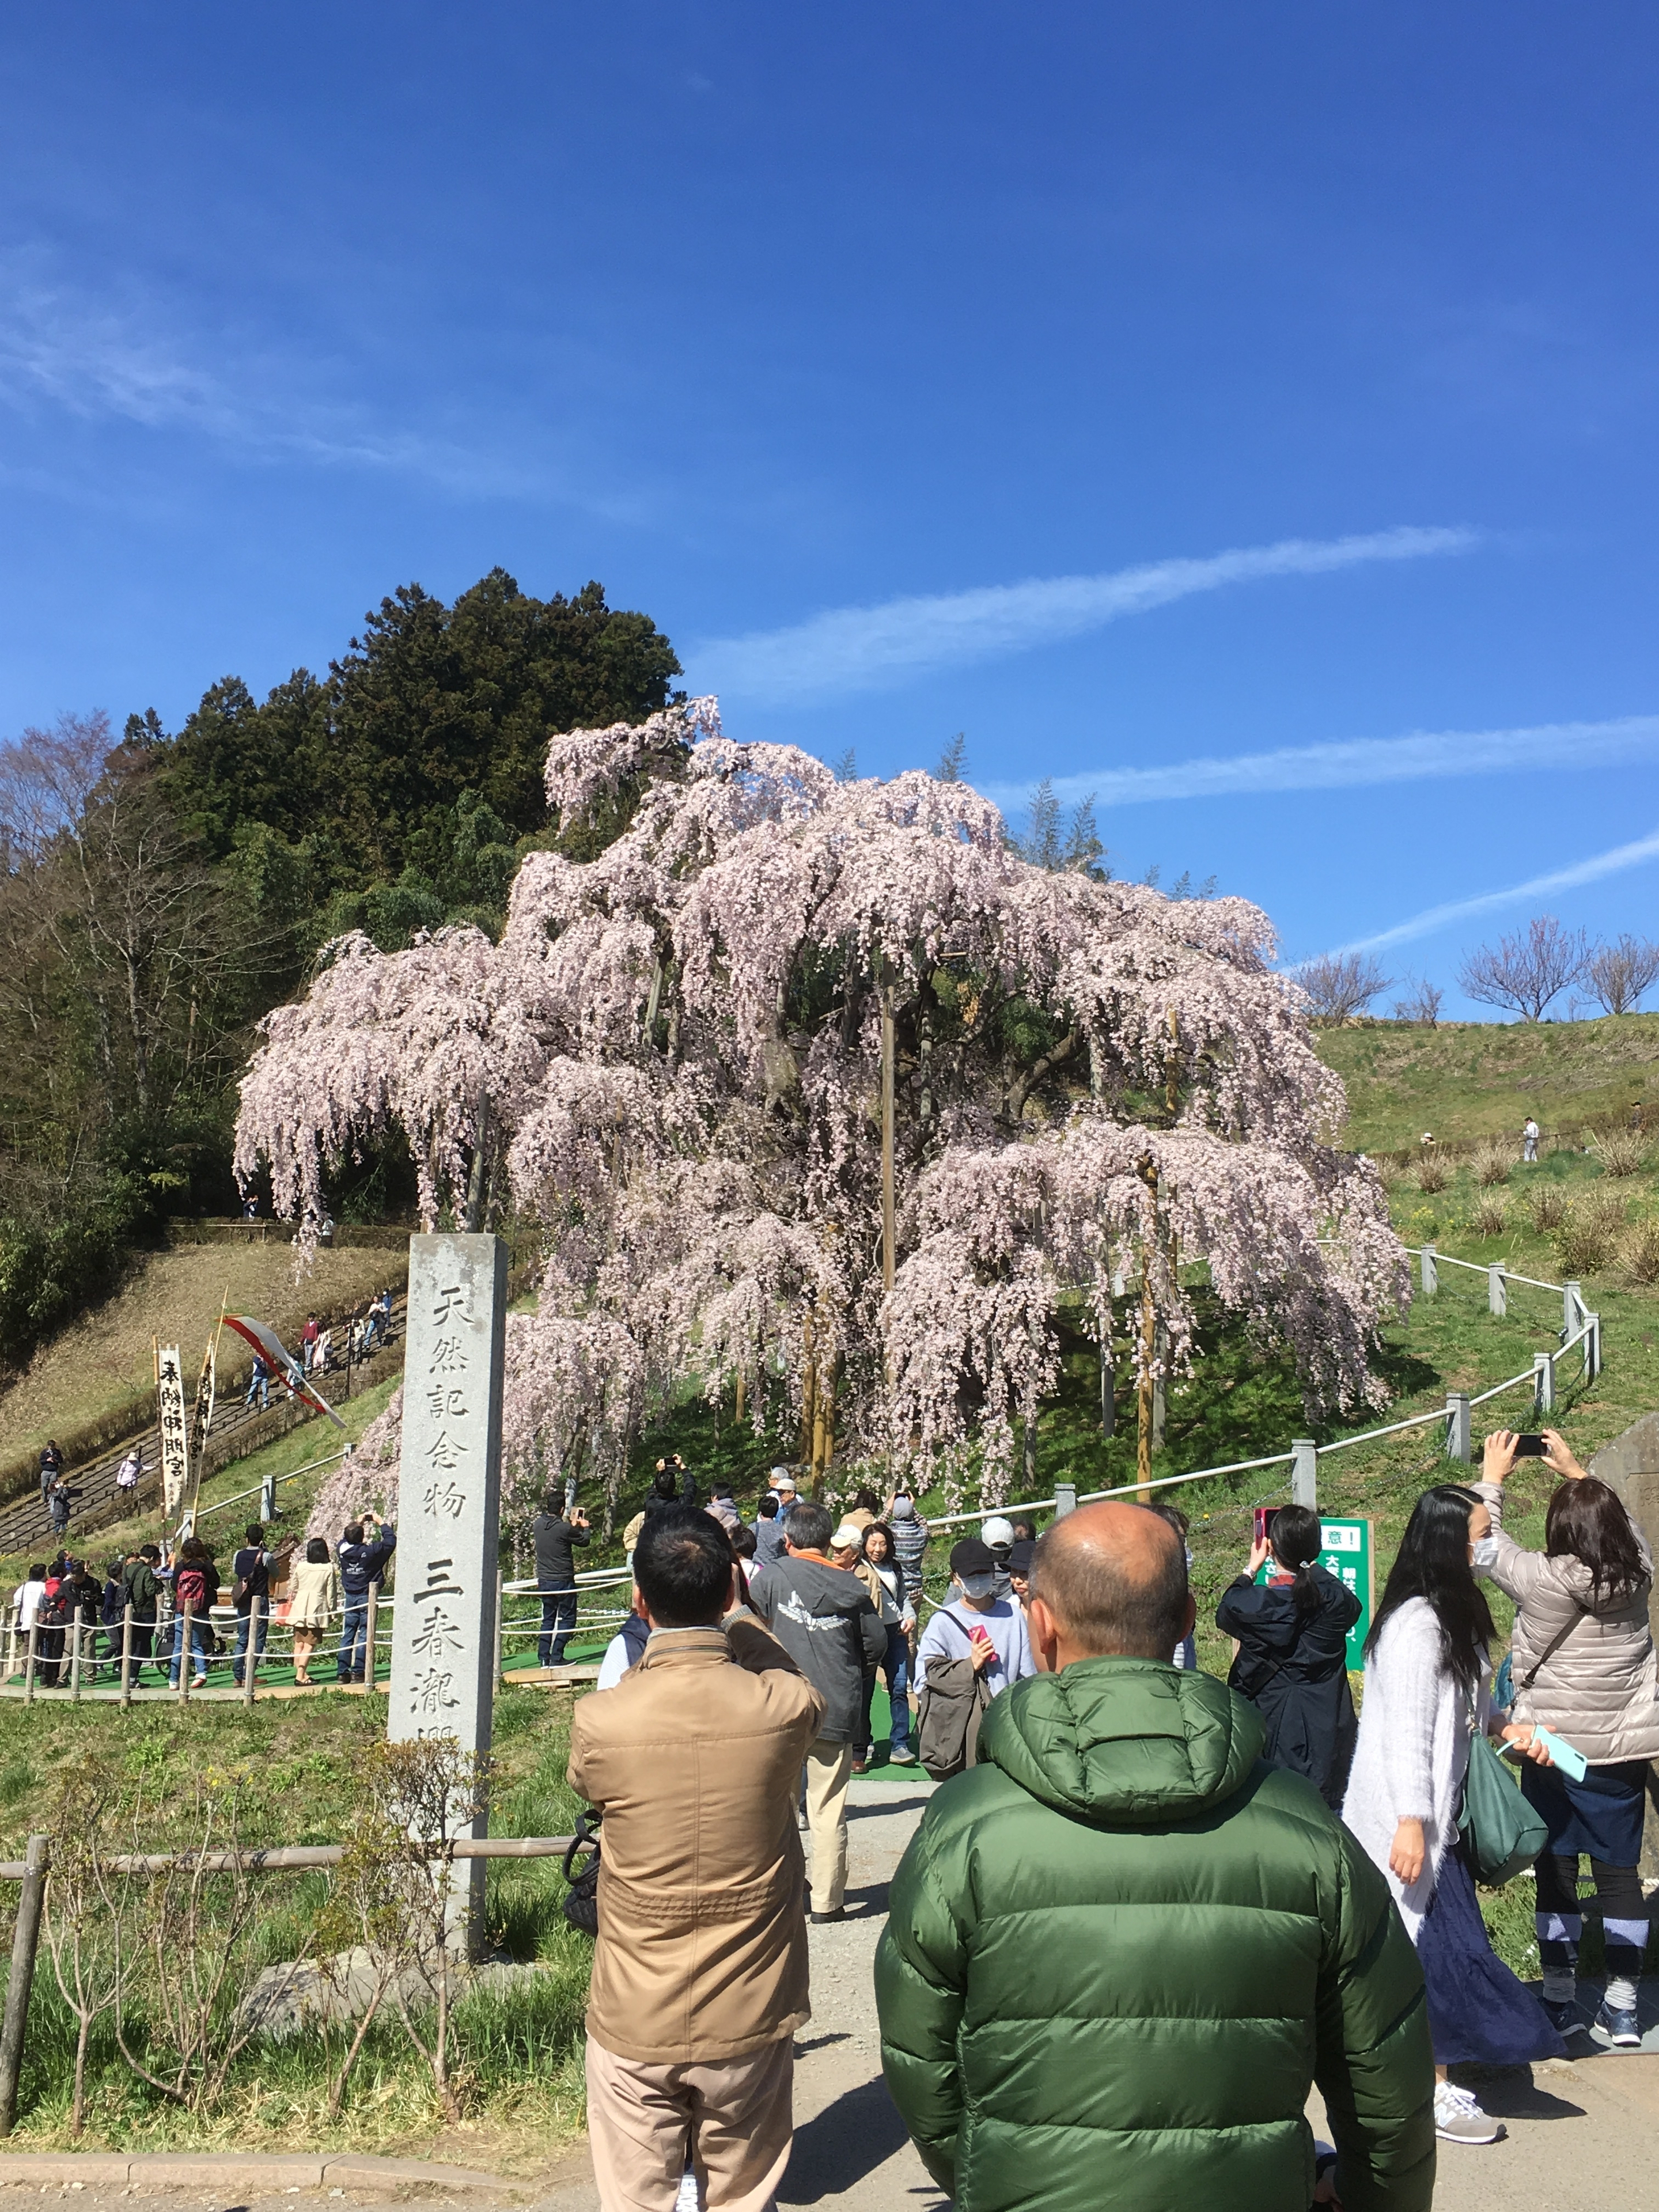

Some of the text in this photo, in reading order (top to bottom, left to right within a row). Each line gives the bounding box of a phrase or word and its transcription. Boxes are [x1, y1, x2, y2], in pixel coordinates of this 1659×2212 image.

[424, 1286, 474, 1519] 天然記念物
[1342, 1567, 1356, 1596] 朝は
